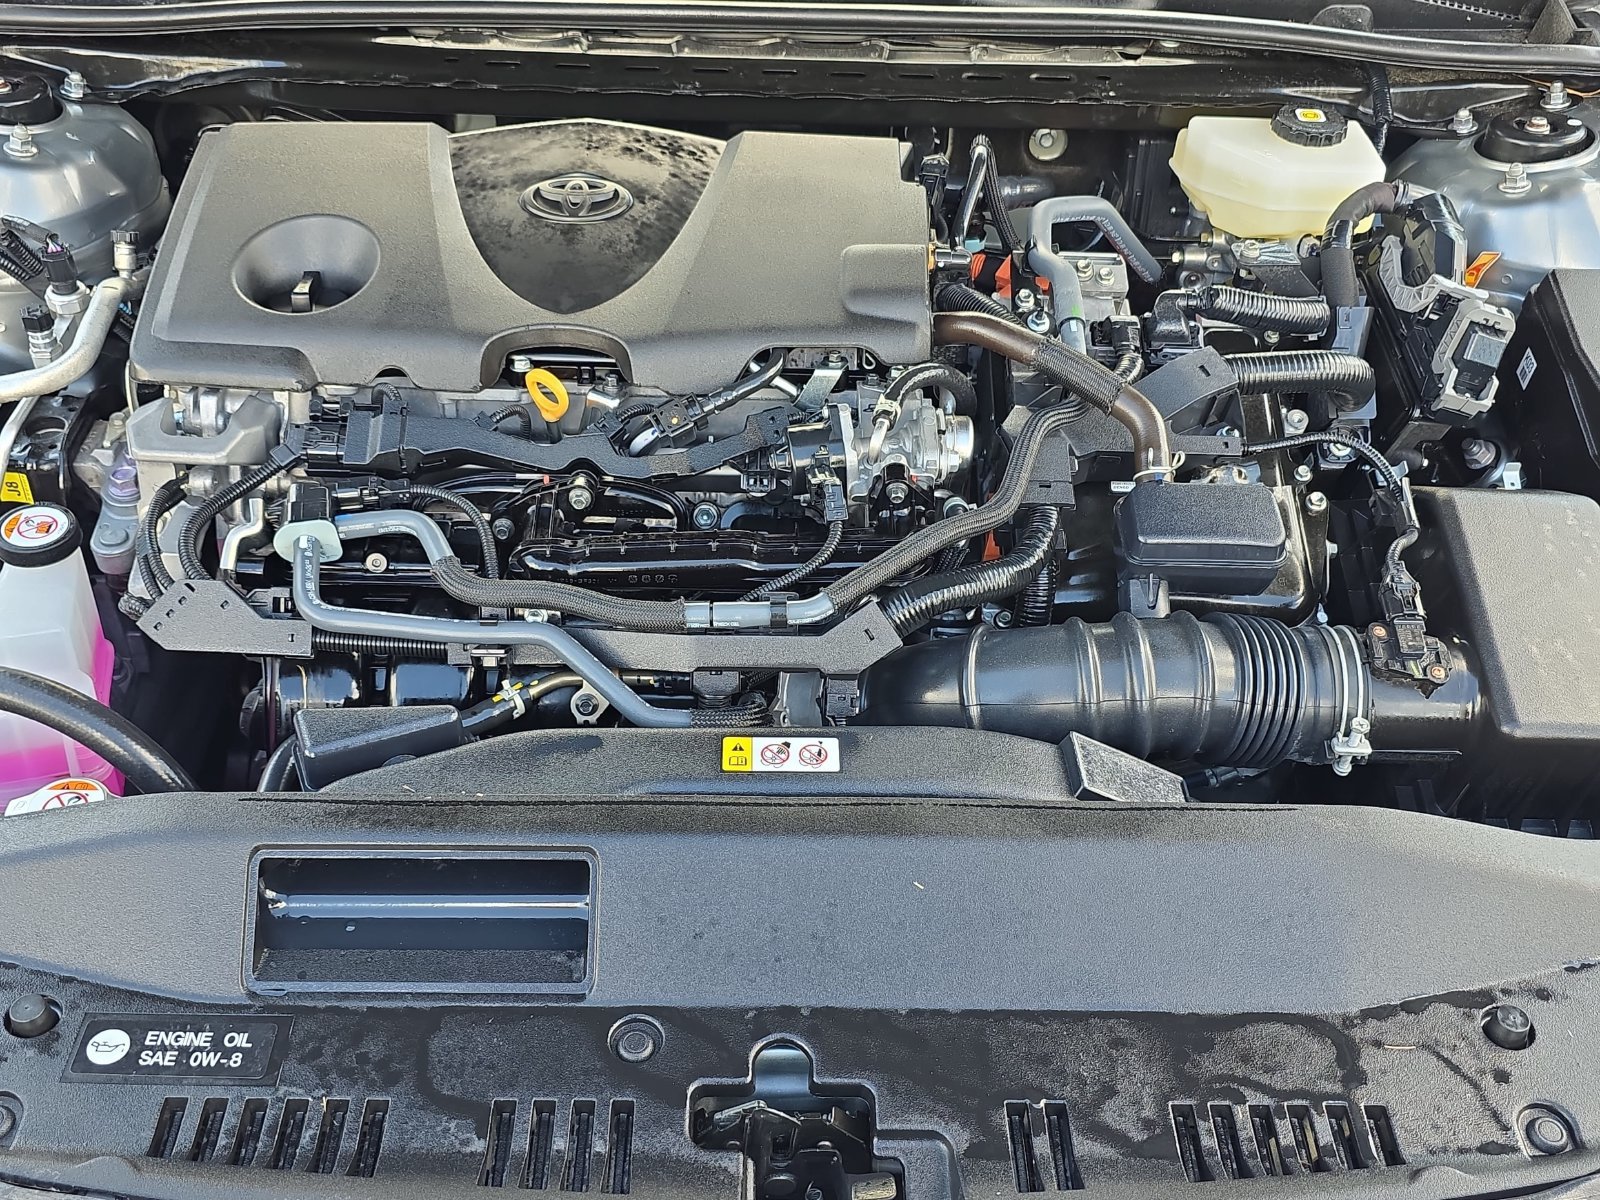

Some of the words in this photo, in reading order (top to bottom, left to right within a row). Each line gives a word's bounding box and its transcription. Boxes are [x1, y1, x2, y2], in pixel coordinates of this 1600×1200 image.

[5, 481, 21, 496] J8
[144, 1031, 213, 1047] ENGINE
[223, 1032, 253, 1048] OIL
[138, 1050, 178, 1066] SAE
[189, 1051, 243, 1068] 0W-8
